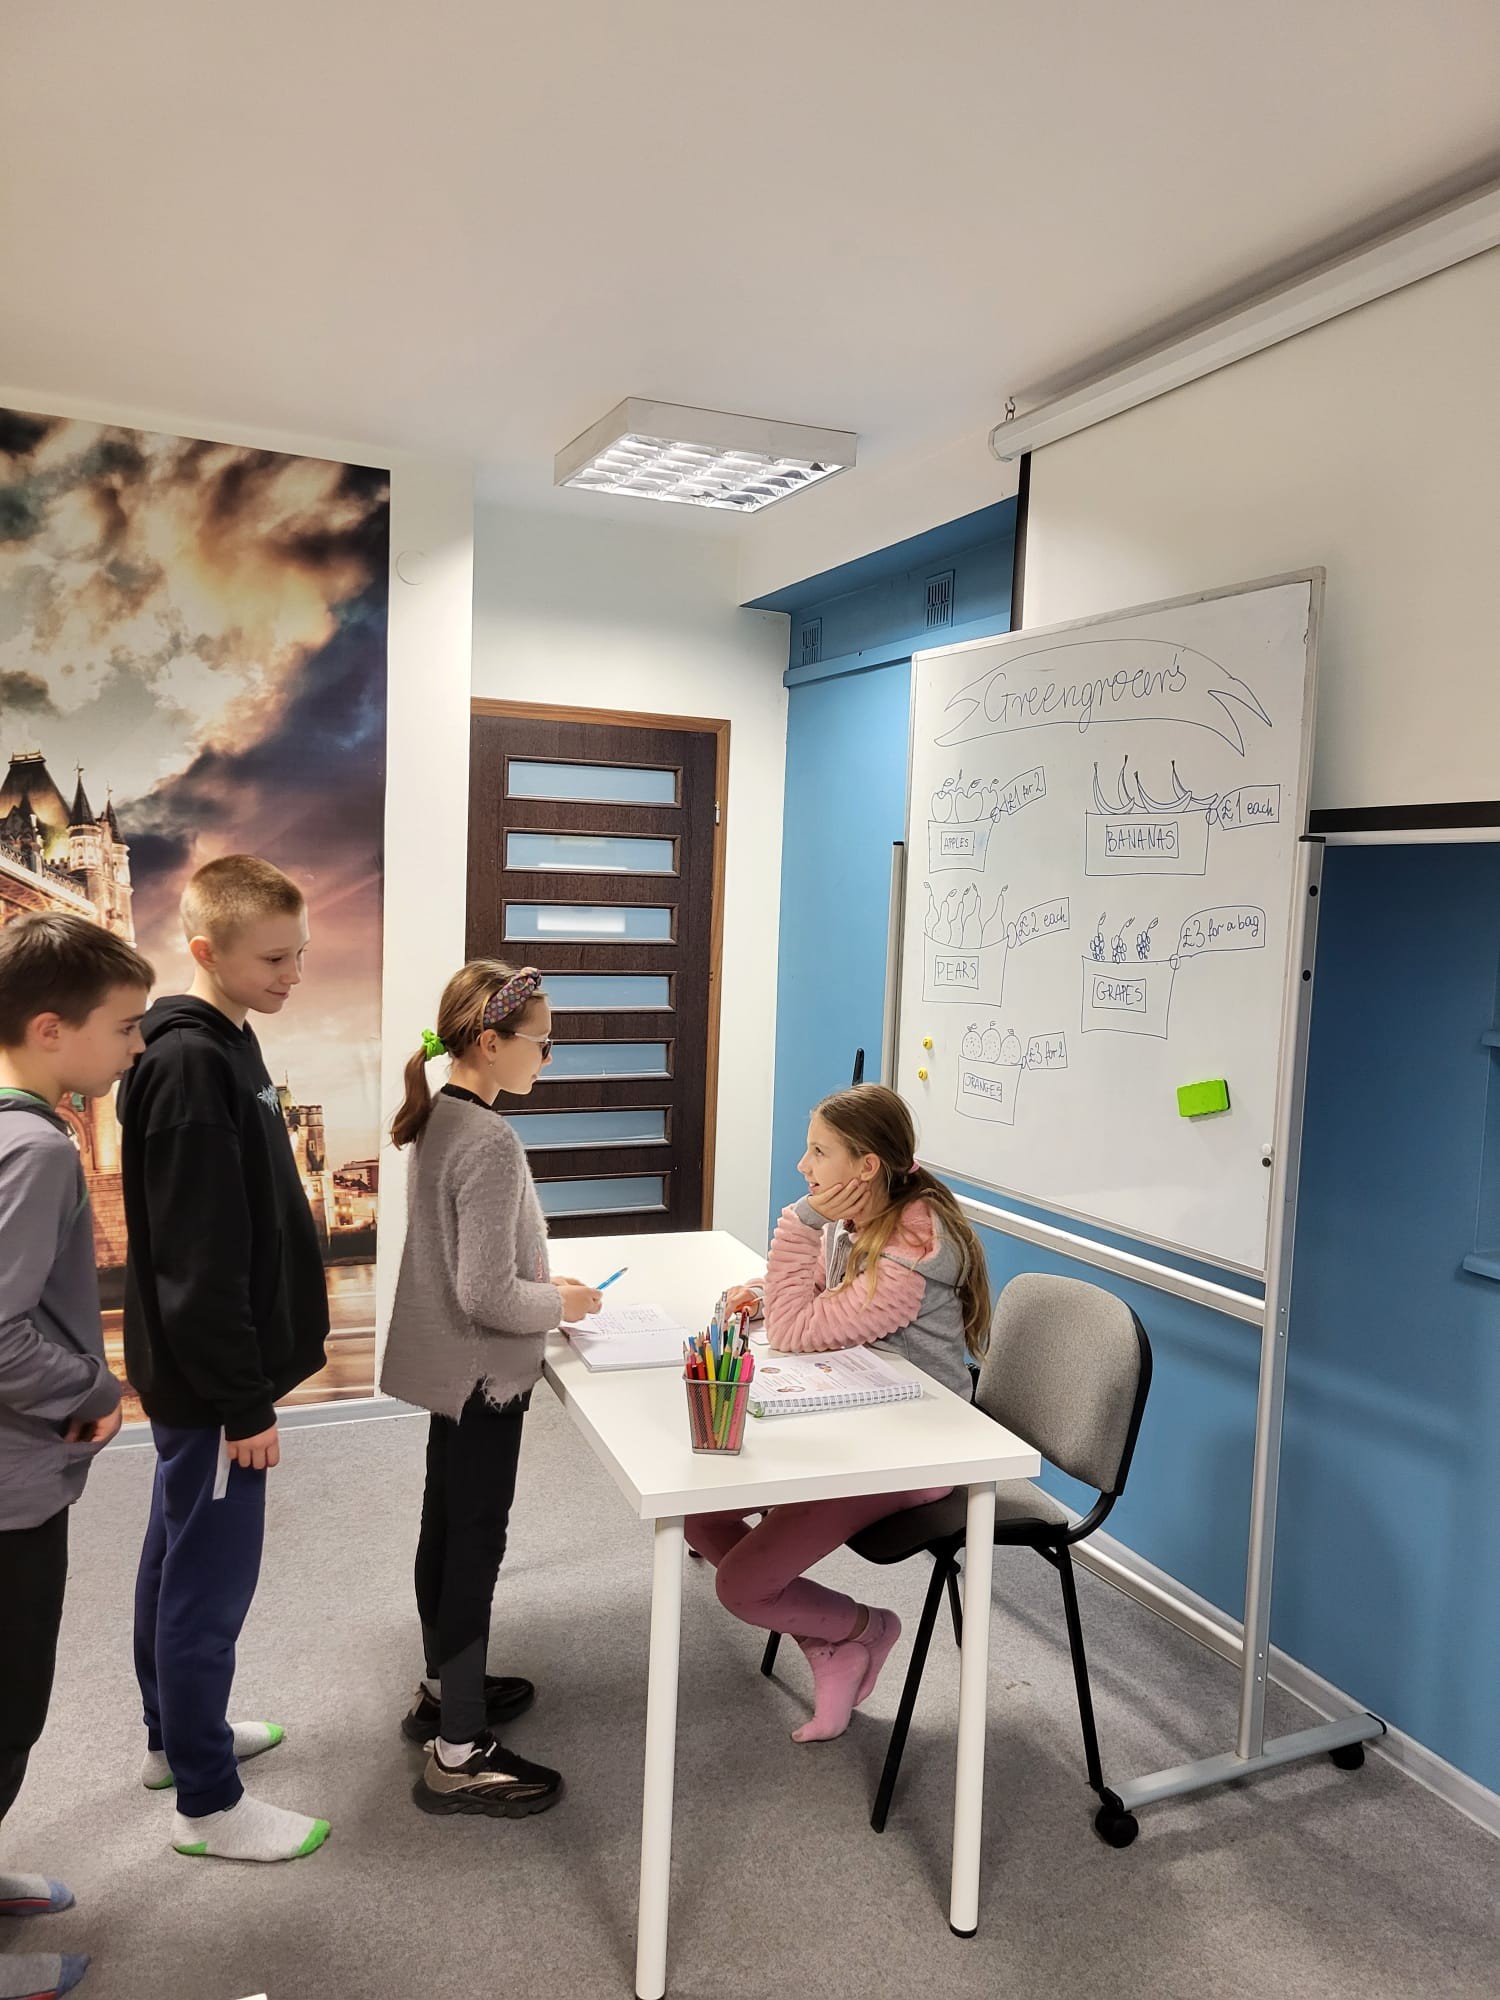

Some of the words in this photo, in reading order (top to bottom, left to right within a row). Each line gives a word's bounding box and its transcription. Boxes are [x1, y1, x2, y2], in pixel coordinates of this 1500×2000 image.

[1034, 771, 1044, 793] 2
[1221, 791, 1242, 824] £1
[1247, 798, 1275, 818] each
[943, 837, 969, 851] APPLES
[1107, 826, 1176, 853] BANANAS
[1018, 911, 1040, 938] £2
[1043, 905, 1067, 928] each
[1182, 919, 1206, 949] £3
[1208, 918, 1225, 943] for
[1226, 921, 1237, 932] a
[1237, 914, 1260, 938] bag
[936, 960, 977, 982] PEARS
[1095, 980, 1144, 1006] GRAPES
